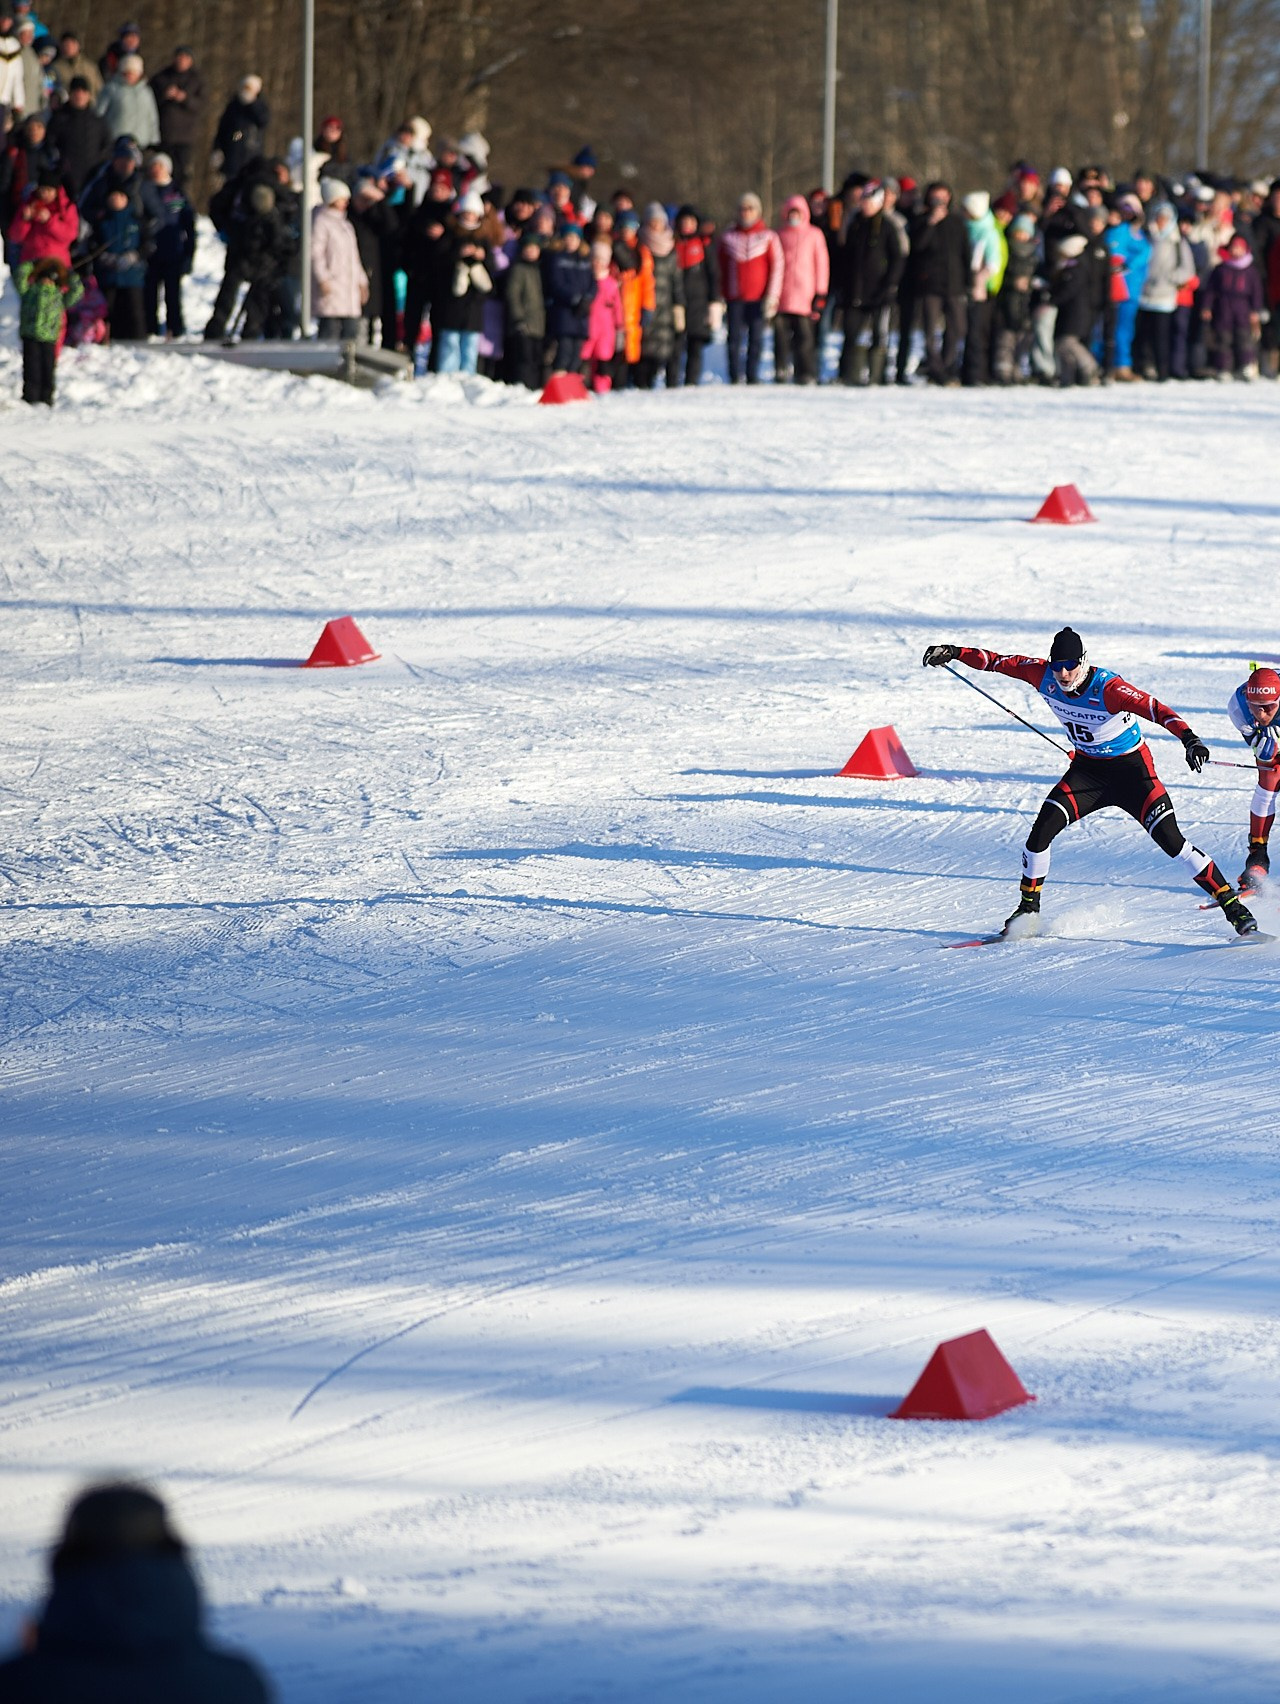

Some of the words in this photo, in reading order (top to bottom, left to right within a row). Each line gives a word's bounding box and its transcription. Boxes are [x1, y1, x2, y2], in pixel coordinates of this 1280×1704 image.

[1247, 686, 1277, 695] LUKOIL
[1053, 705, 1107, 721] ФОСАГРО
[1063, 721, 1095, 742] 15
[1191, 845, 1206, 858] 1
